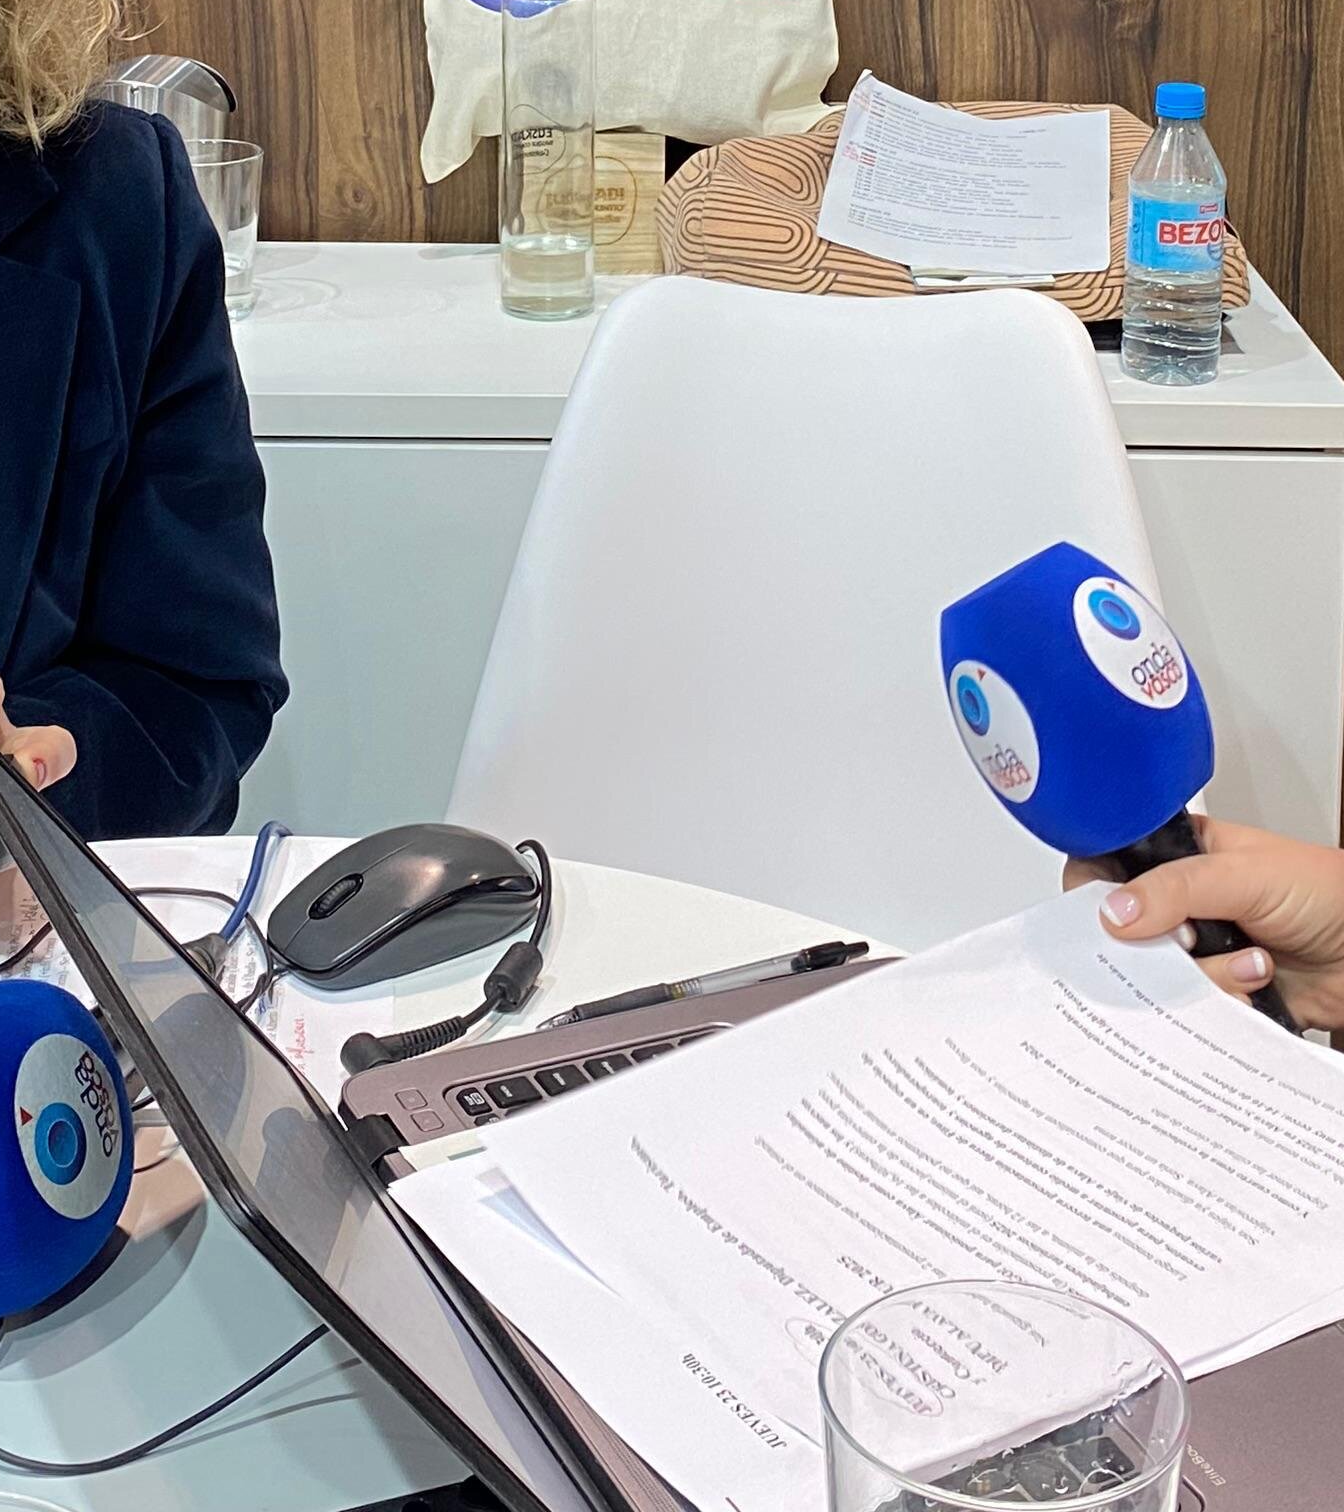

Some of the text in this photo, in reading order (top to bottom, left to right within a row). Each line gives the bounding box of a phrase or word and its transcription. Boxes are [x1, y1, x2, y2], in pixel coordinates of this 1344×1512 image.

[1159, 218, 1226, 246] BEZO
[1131, 641, 1175, 686] onda
[1140, 661, 1184, 701] vasca
[74, 1061, 114, 1158] onda
[78, 1050, 120, 1142] vasca
[737, 1241, 796, 1287] Diputada
[835, 1254, 873, 1280] 2025
[681, 1352, 788, 1449] JUEVES 23 10:30h
[1185, 1442, 1227, 1487] EliteBo
